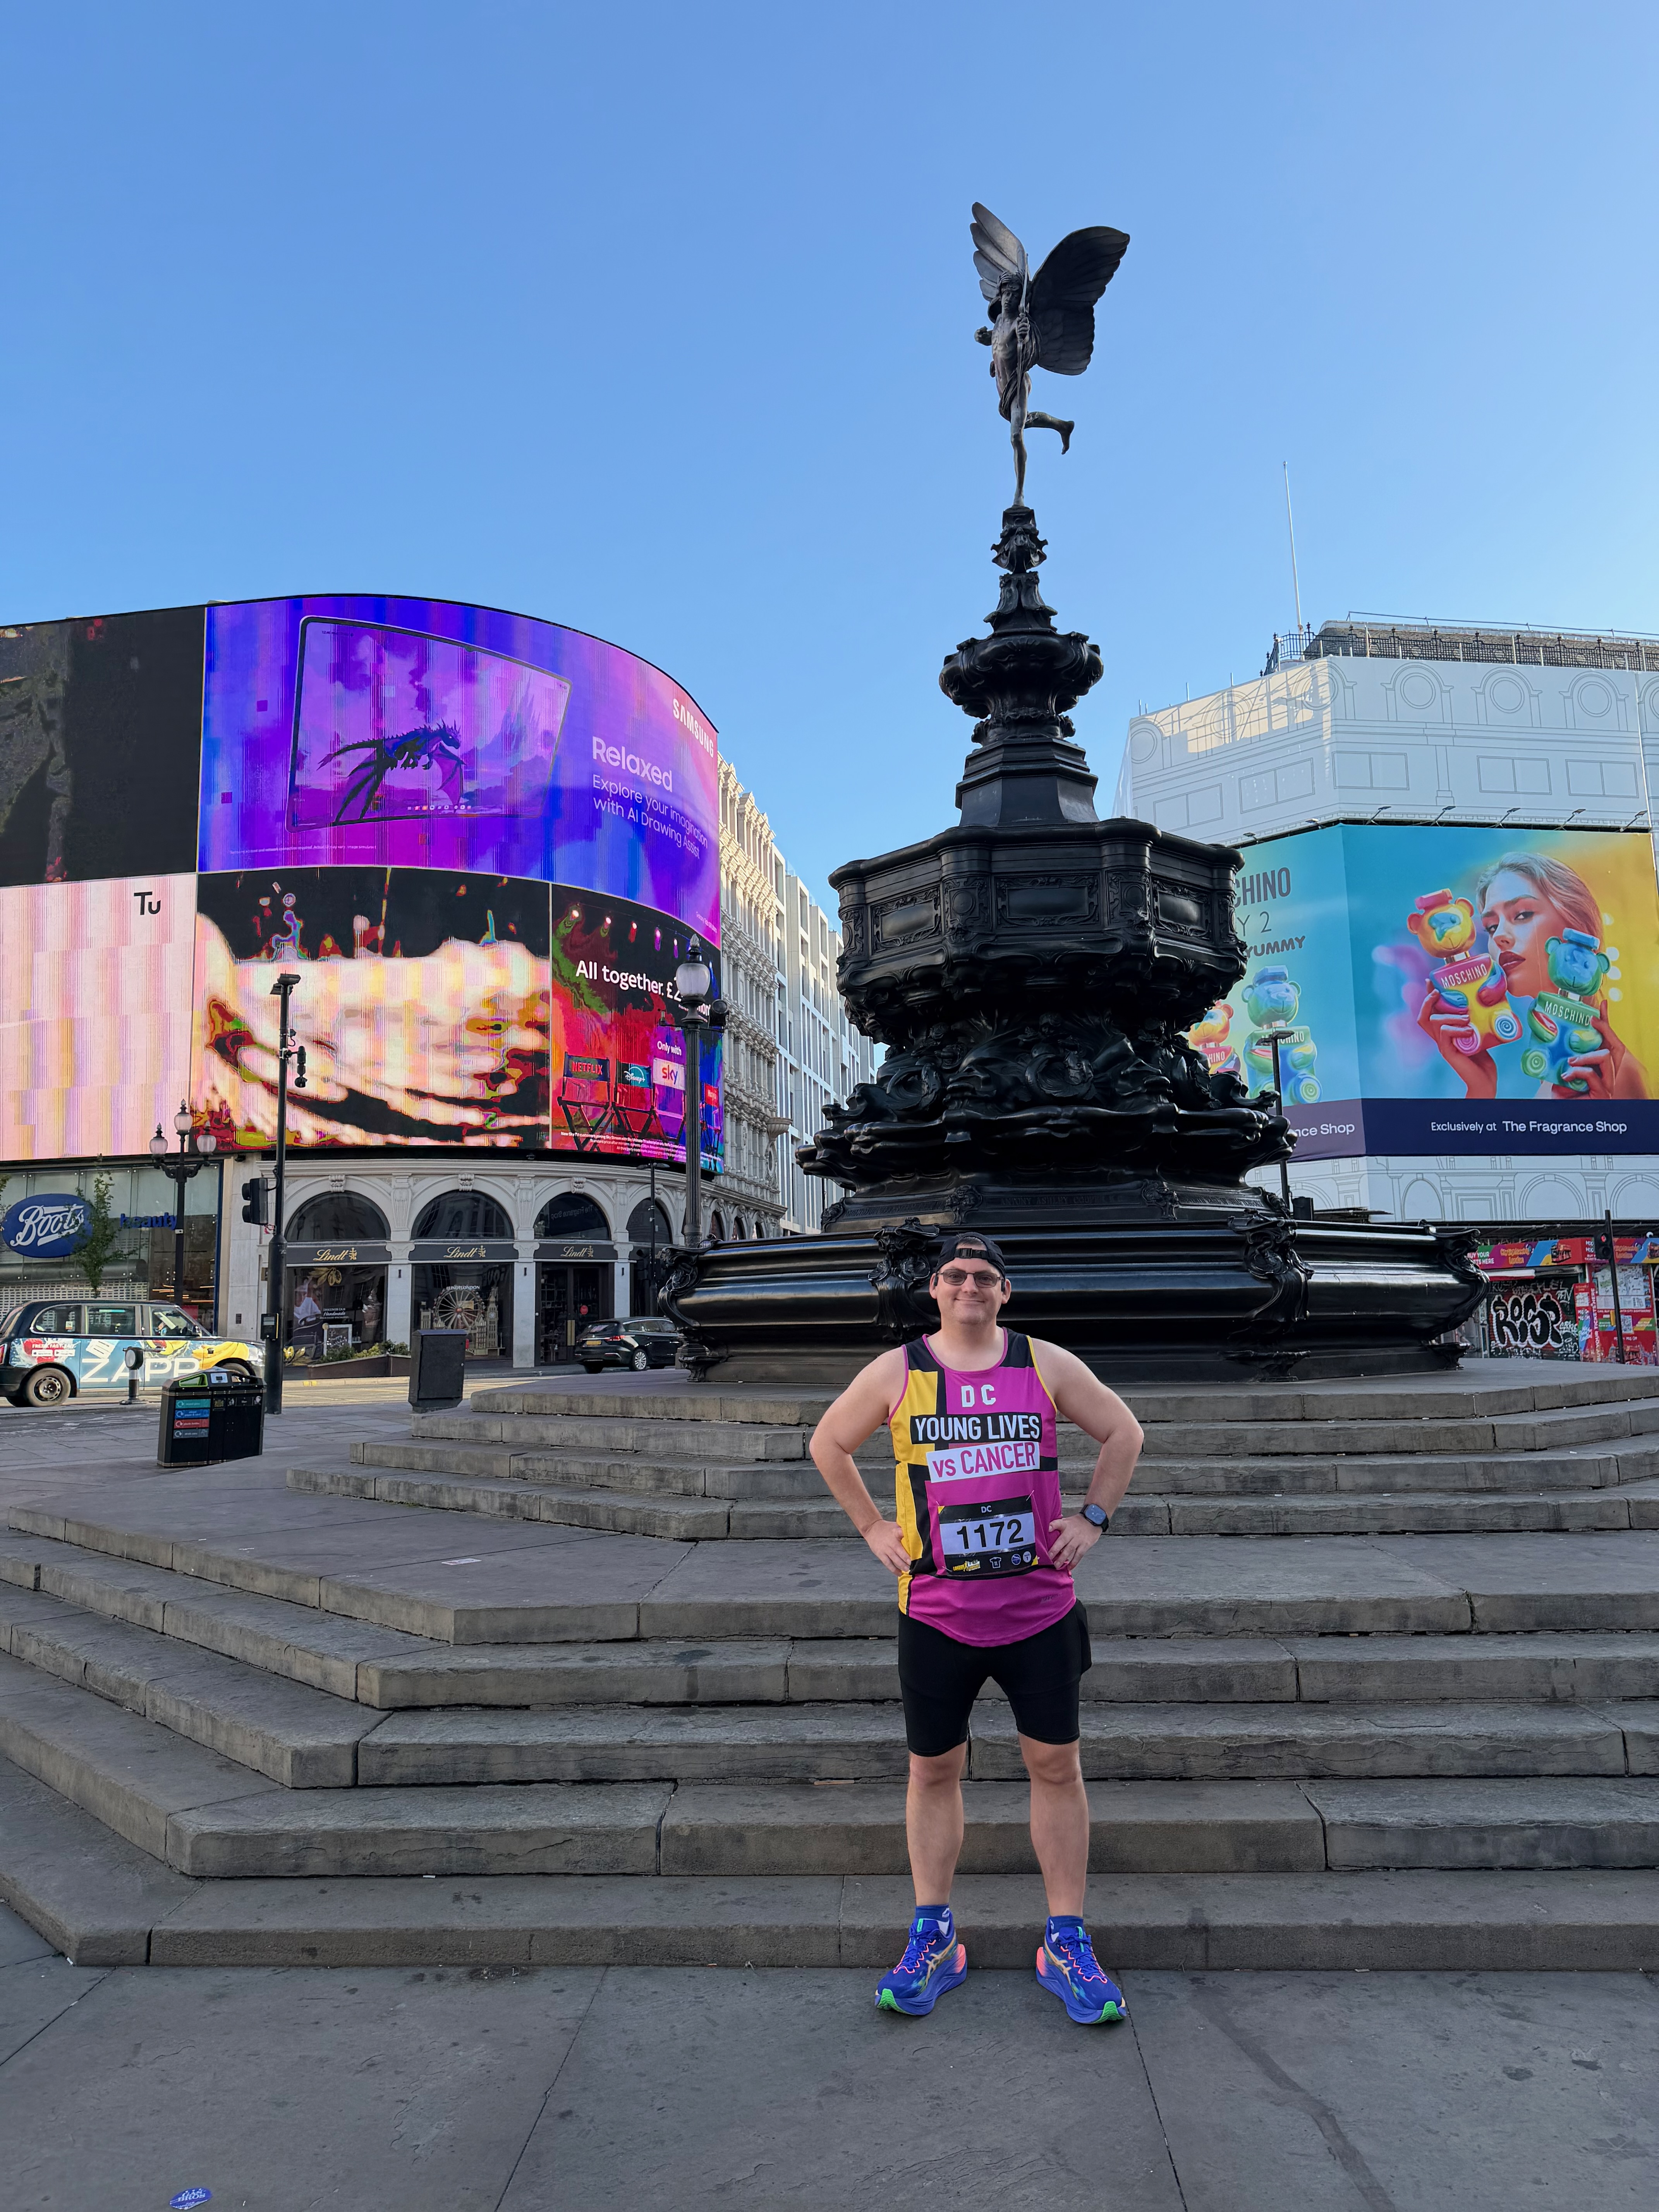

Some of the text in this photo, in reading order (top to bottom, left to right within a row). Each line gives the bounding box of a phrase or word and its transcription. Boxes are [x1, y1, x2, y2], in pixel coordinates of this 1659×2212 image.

[673, 698, 714, 758] SAMSUNG
[592, 736, 673, 793] Relaxed
[593, 774, 708, 849] Explore your imagination
[593, 797, 700, 859] with AI Drawing Assist
[1235, 867, 1291, 908] CHINO
[134, 891, 161, 915] Tu
[1260, 911, 1271, 933] 2
[1245, 936, 1305, 958] YUMMY
[576, 960, 597, 980] All
[602, 965, 664, 996] together.
[1441, 963, 1488, 989] MOSCHINO
[1545, 1001, 1590, 1027] MOSCHINO
[657, 1041, 682, 1056] Only with
[572, 1061, 603, 1075] NETFLIX
[662, 1065, 678, 1085] sky
[1320, 1123, 1355, 1135] Shop
[1431, 1121, 1627, 1134] Exclusively at The Fragrance Shop
[10, 1204, 84, 1246] Boots
[120, 1212, 177, 1230] beauty
[313, 1249, 349, 1261] Lindt
[443, 1247, 478, 1258] Lindt
[560, 1246, 588, 1257] Lindt
[80, 1358, 200, 1382] ZAPP
[915, 1415, 1040, 1441] YOUNG LIVES
[960, 1442, 1035, 1472] CANCER
[981, 1505, 992, 1513] DC
[957, 1519, 1024, 1549] 1172
